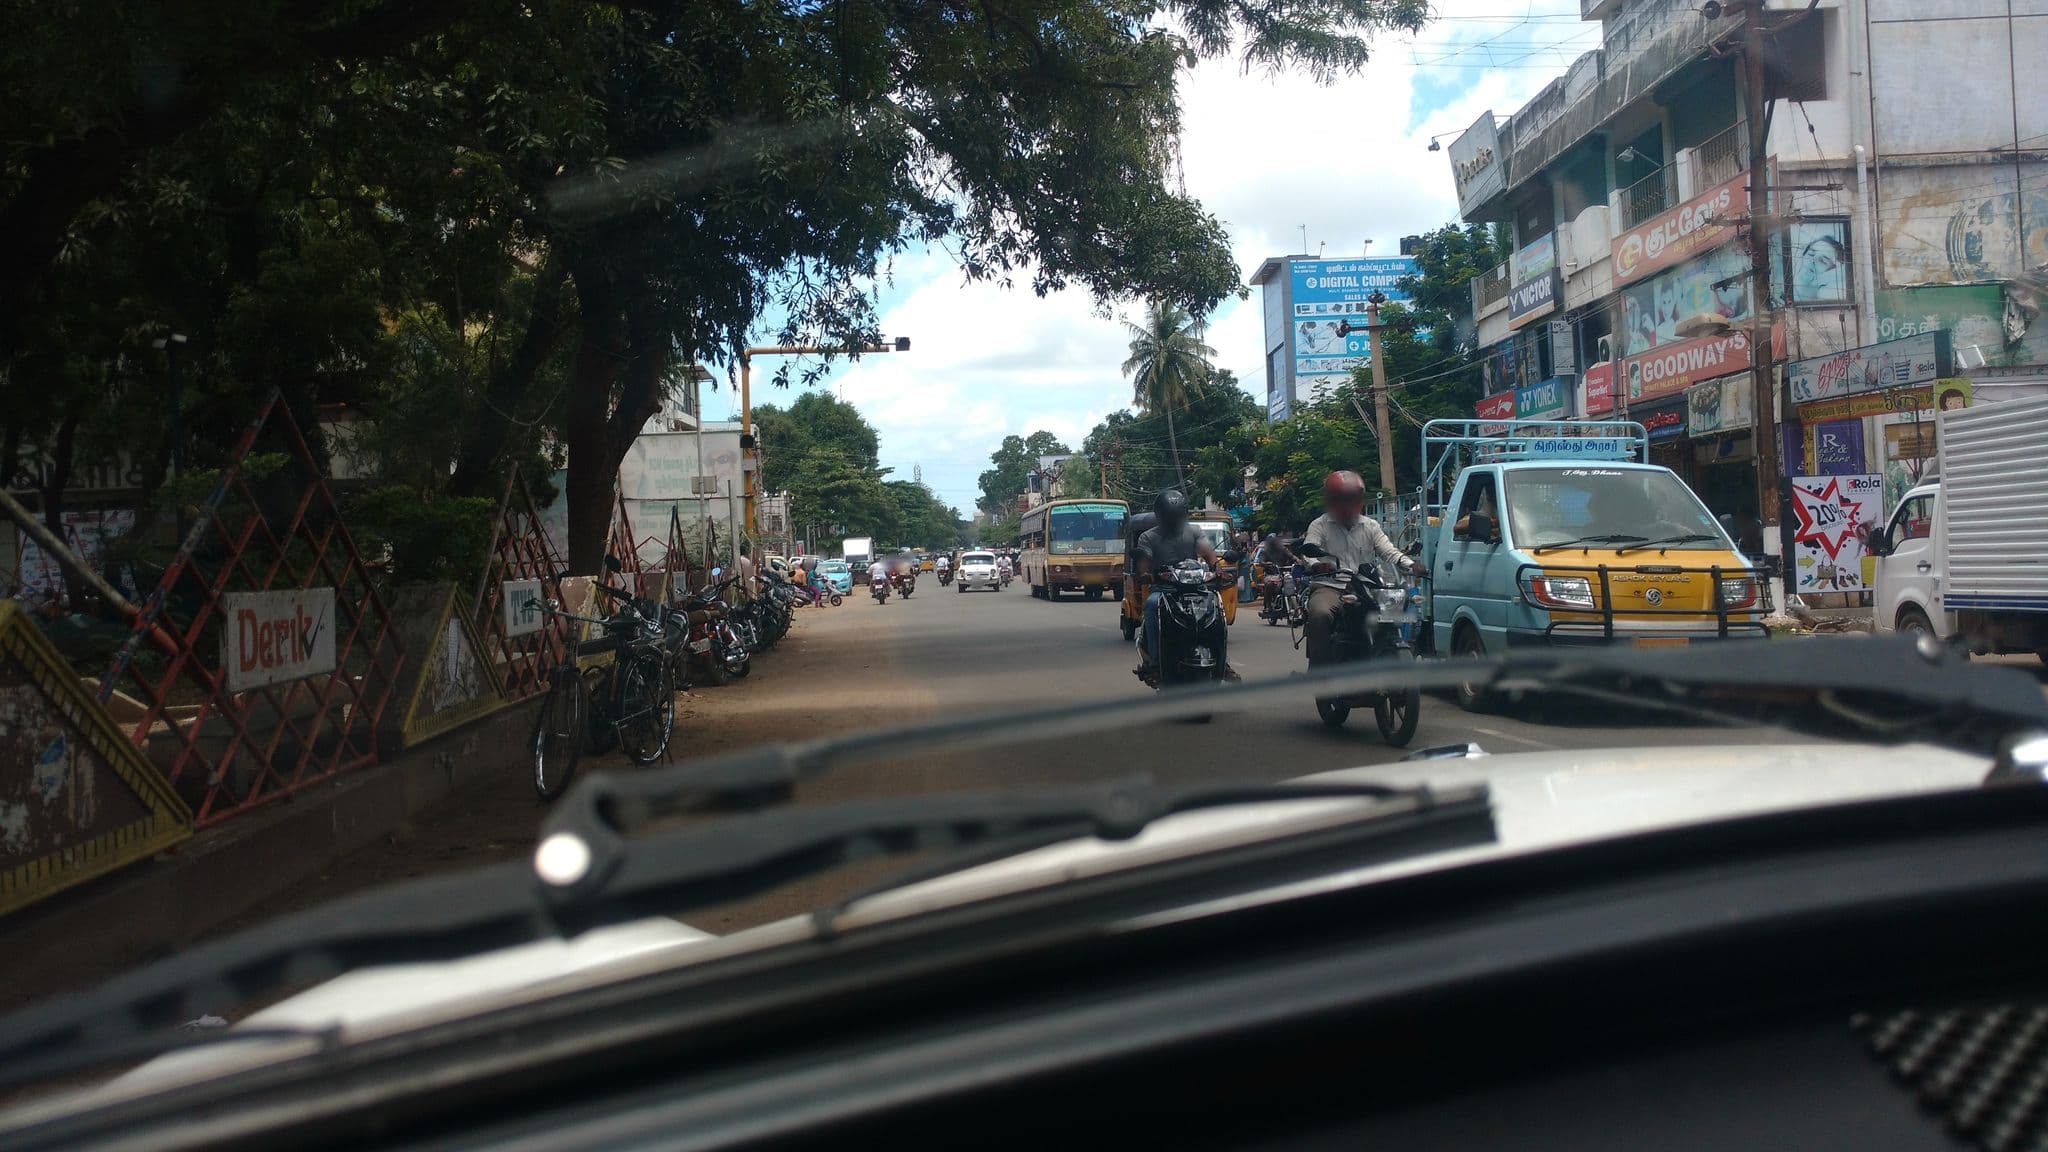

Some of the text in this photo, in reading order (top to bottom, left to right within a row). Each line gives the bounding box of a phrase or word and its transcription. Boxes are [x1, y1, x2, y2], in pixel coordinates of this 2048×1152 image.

[1319, 276, 1360, 289] DIGITAL
[1519, 276, 1551, 307] VICTOR
[1642, 331, 1746, 383] GOODWAY'S
[1533, 383, 1557, 409] YONEX
[1585, 439, 1618, 452] அரசர்
[1854, 476, 1881, 489] Roja
[1808, 503, 1847, 526] 20%
[1613, 575, 1692, 583] ASHOK LEYLAND
